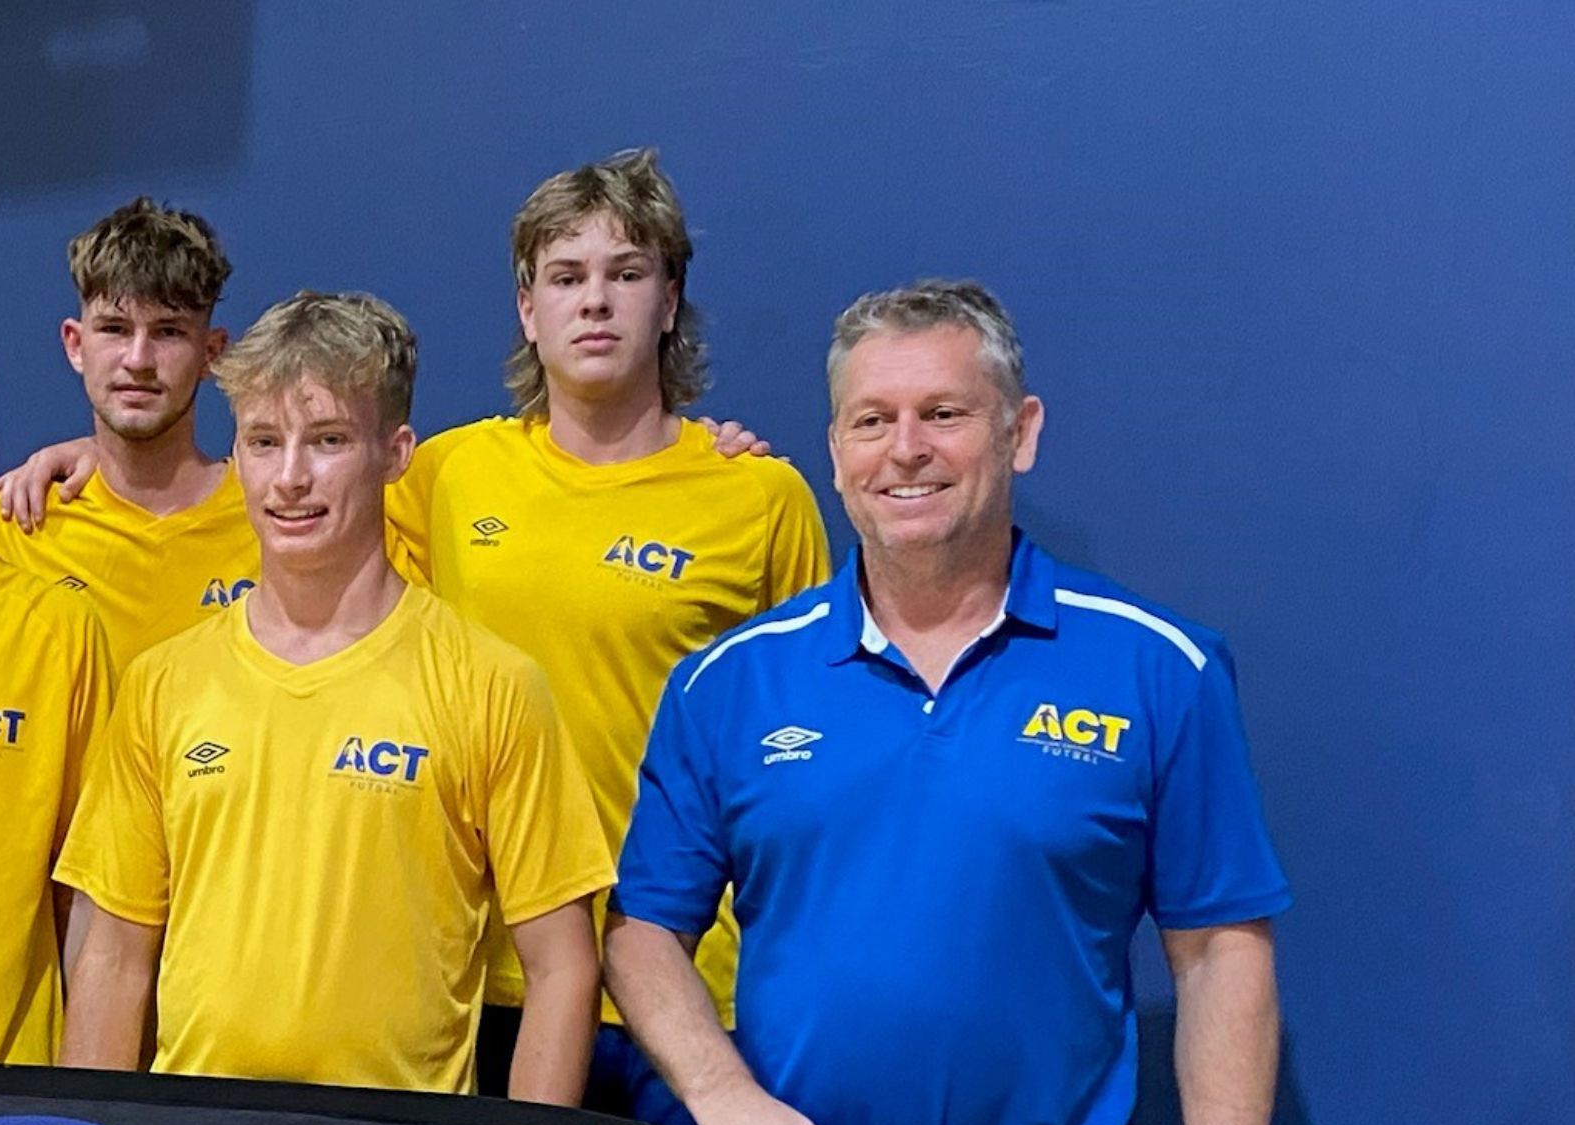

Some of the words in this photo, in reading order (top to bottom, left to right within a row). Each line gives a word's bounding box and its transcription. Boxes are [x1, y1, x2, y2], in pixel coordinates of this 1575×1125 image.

[604, 535, 695, 580] ACT
[201, 578, 256, 608] AC
[1022, 703, 1131, 753] ACT
[187, 765, 225, 778] umbro
[333, 737, 429, 782] ACT
[763, 750, 813, 765] umbro
